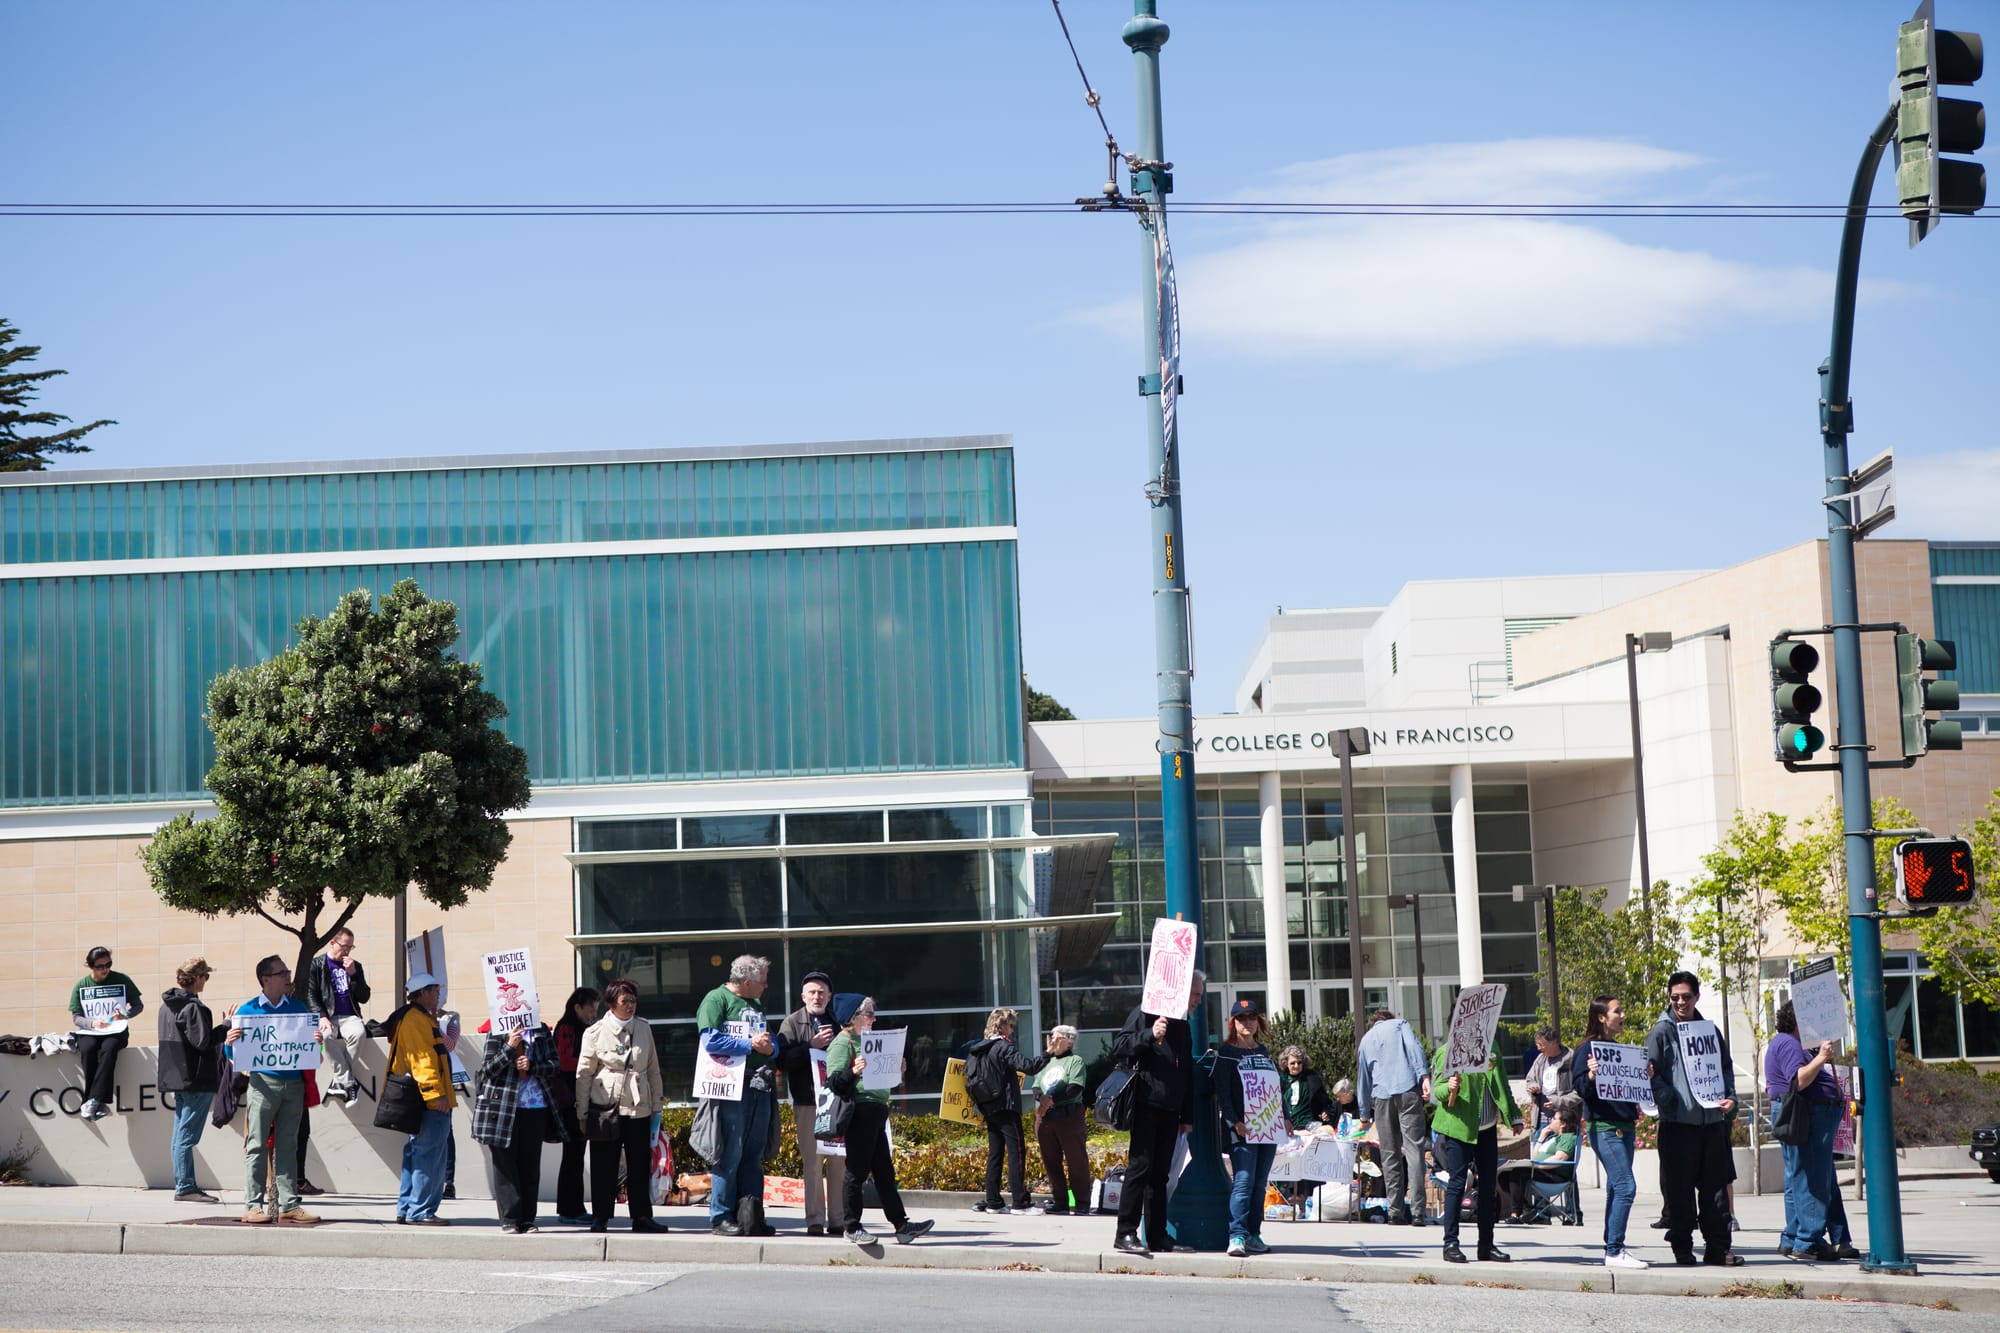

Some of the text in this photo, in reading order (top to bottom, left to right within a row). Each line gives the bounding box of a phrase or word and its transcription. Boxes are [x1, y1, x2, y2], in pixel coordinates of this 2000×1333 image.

[1211, 734, 1302, 752] COLLEGE
[1396, 726, 1514, 744] FRANCISCO
[1175, 755, 1182, 778] 84
[1951, 851, 1969, 891] 5
[487, 952, 525, 966] NO JUSTICE
[494, 962, 526, 974] NO TEACH
[1459, 985, 1498, 1015] STRIKE!
[86, 1001, 119, 1017] HONK
[498, 1013, 533, 1031] STRIKE!
[261, 1042, 316, 1052] CONTRACT
[864, 1039, 883, 1054] ON
[1686, 1035, 1717, 1056] HONK
[252, 1053, 299, 1068] NOW!
[1594, 1047, 1622, 1063] DSPS
[1597, 1064, 1649, 1080] COUNSELORS
[1694, 1058, 1715, 1075] if you
[1243, 1072, 1257, 1085] my
[1694, 1074, 1719, 1087] support
[700, 1082, 735, 1097] STRIKE!
[1245, 1077, 1266, 1100] first
[1599, 1084, 1654, 1102] FAIR CONTRACT
